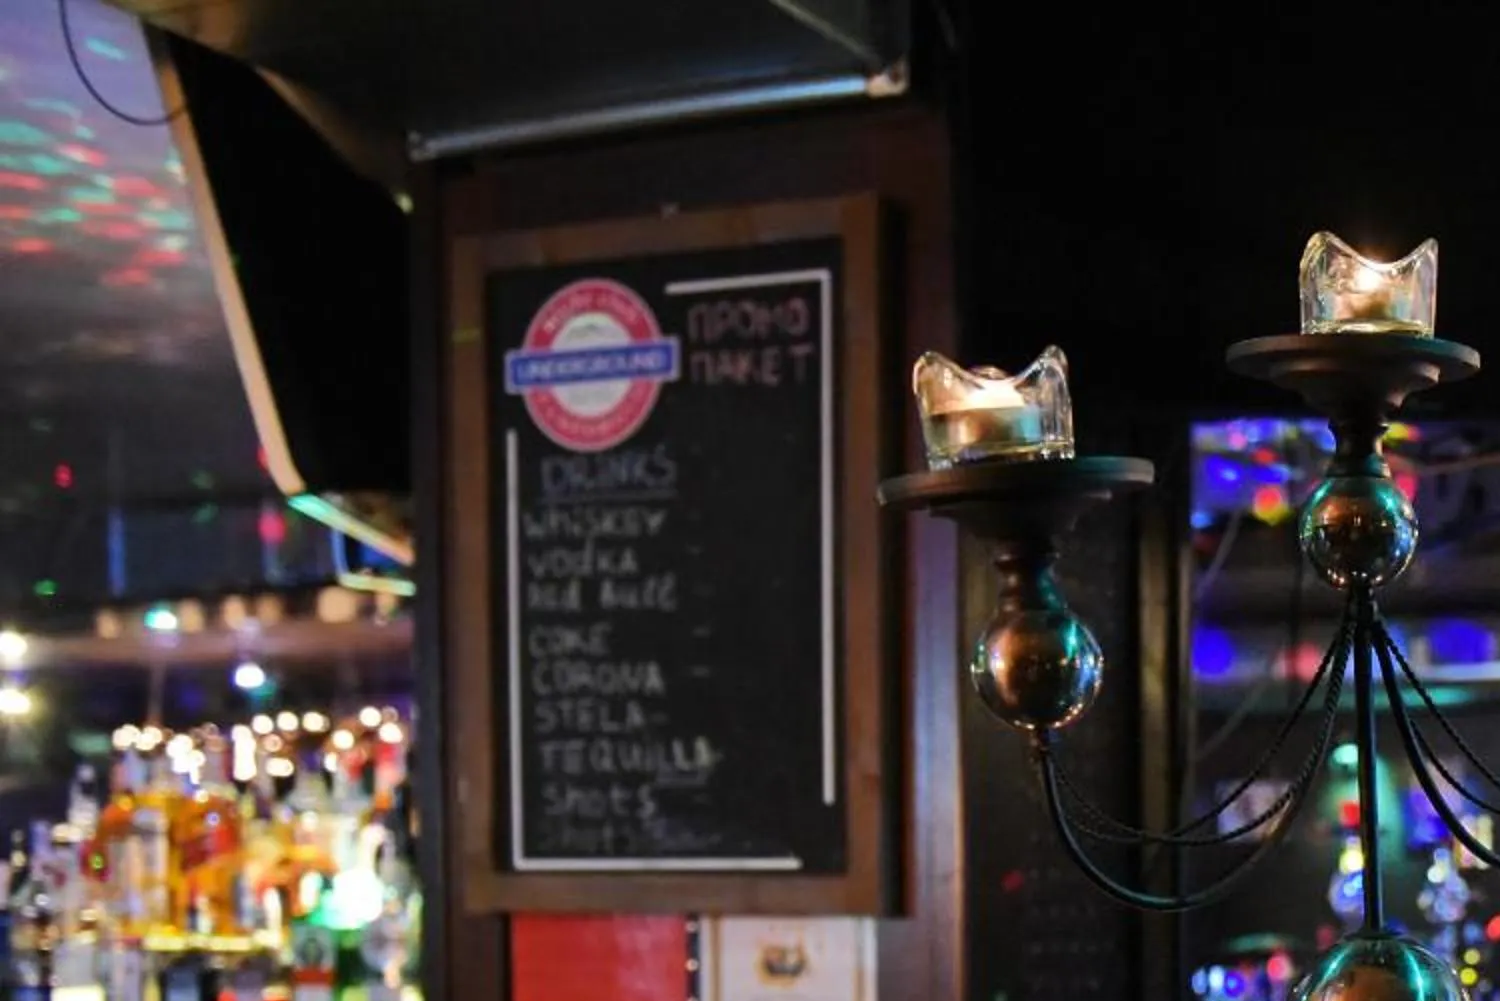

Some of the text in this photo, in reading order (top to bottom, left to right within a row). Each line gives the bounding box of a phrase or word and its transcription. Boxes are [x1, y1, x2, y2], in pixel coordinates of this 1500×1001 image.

[687, 297, 809, 342] ПРОМО
[515, 348, 668, 382] UNDERGROUND
[690, 343, 815, 386] ПАКЕТ
[540, 444, 677, 492] DRINKS
[530, 659, 666, 696] CORONA
